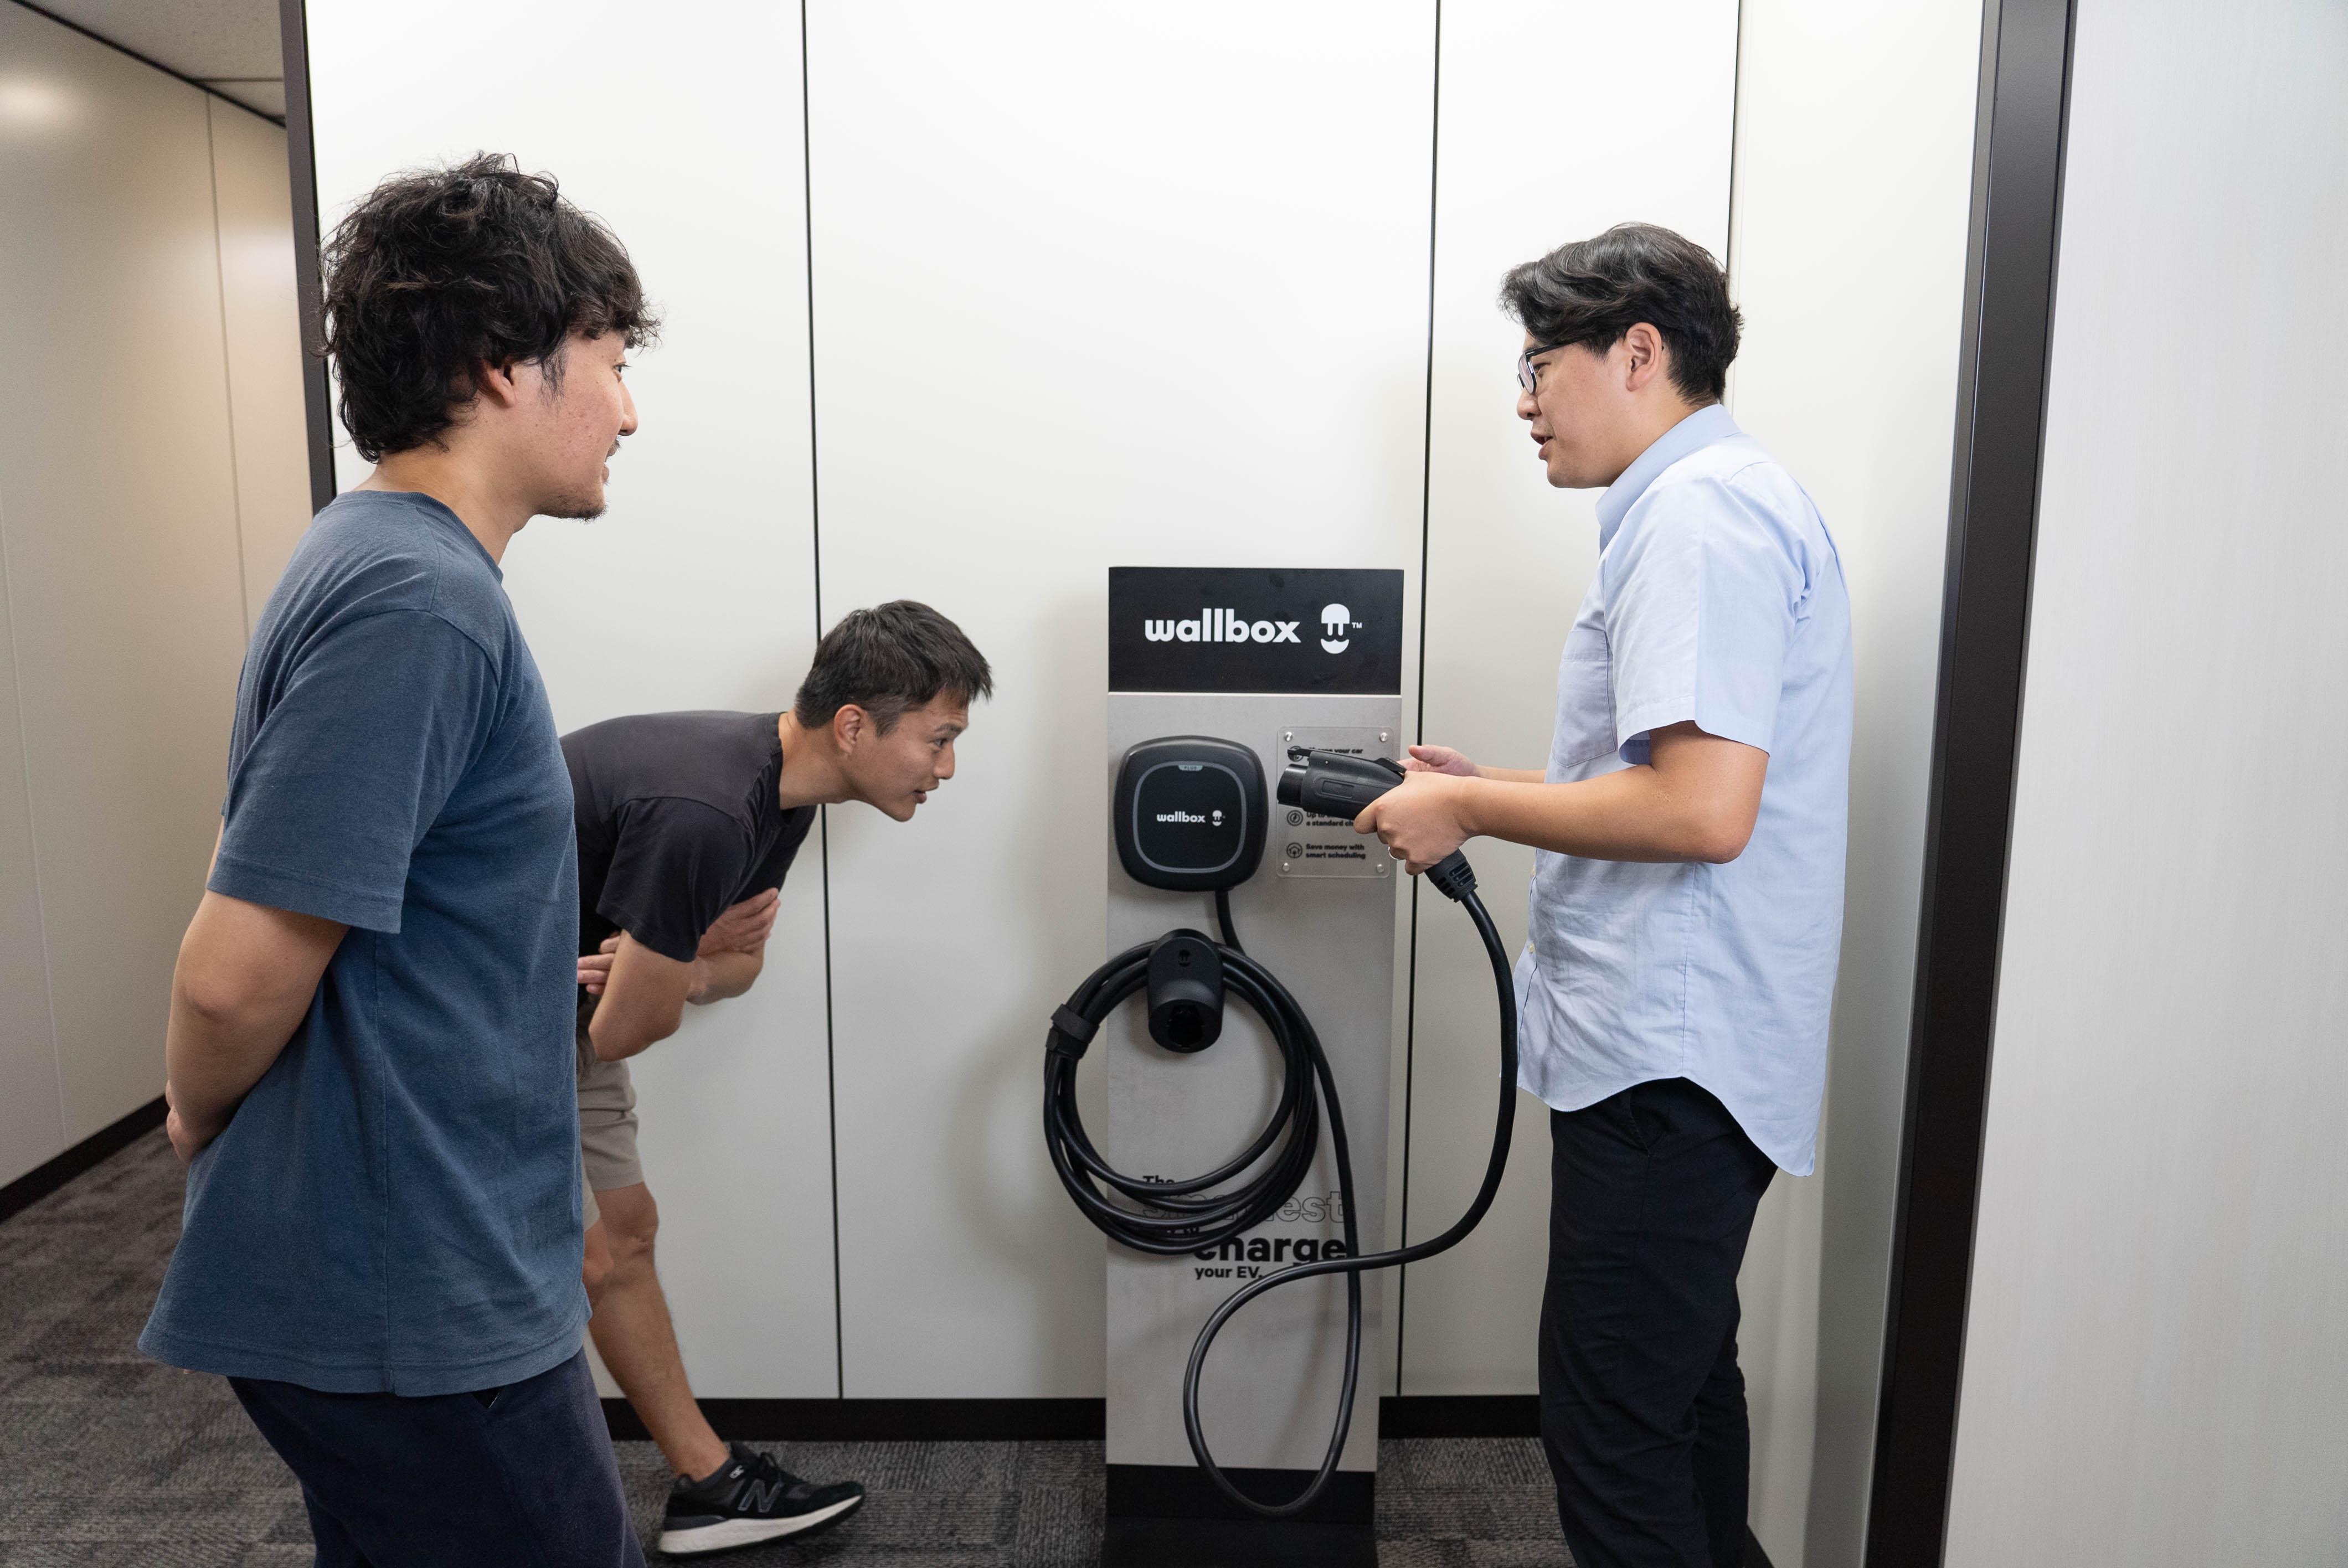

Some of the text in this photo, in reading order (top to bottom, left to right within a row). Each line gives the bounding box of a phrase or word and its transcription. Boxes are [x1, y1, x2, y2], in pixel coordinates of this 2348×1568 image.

[1145, 608, 1301, 643] wallbox
[1156, 811, 1206, 823] wallbox
[1328, 852, 1366, 860] scheduling
[1194, 1266, 1263, 1280] your EV.
